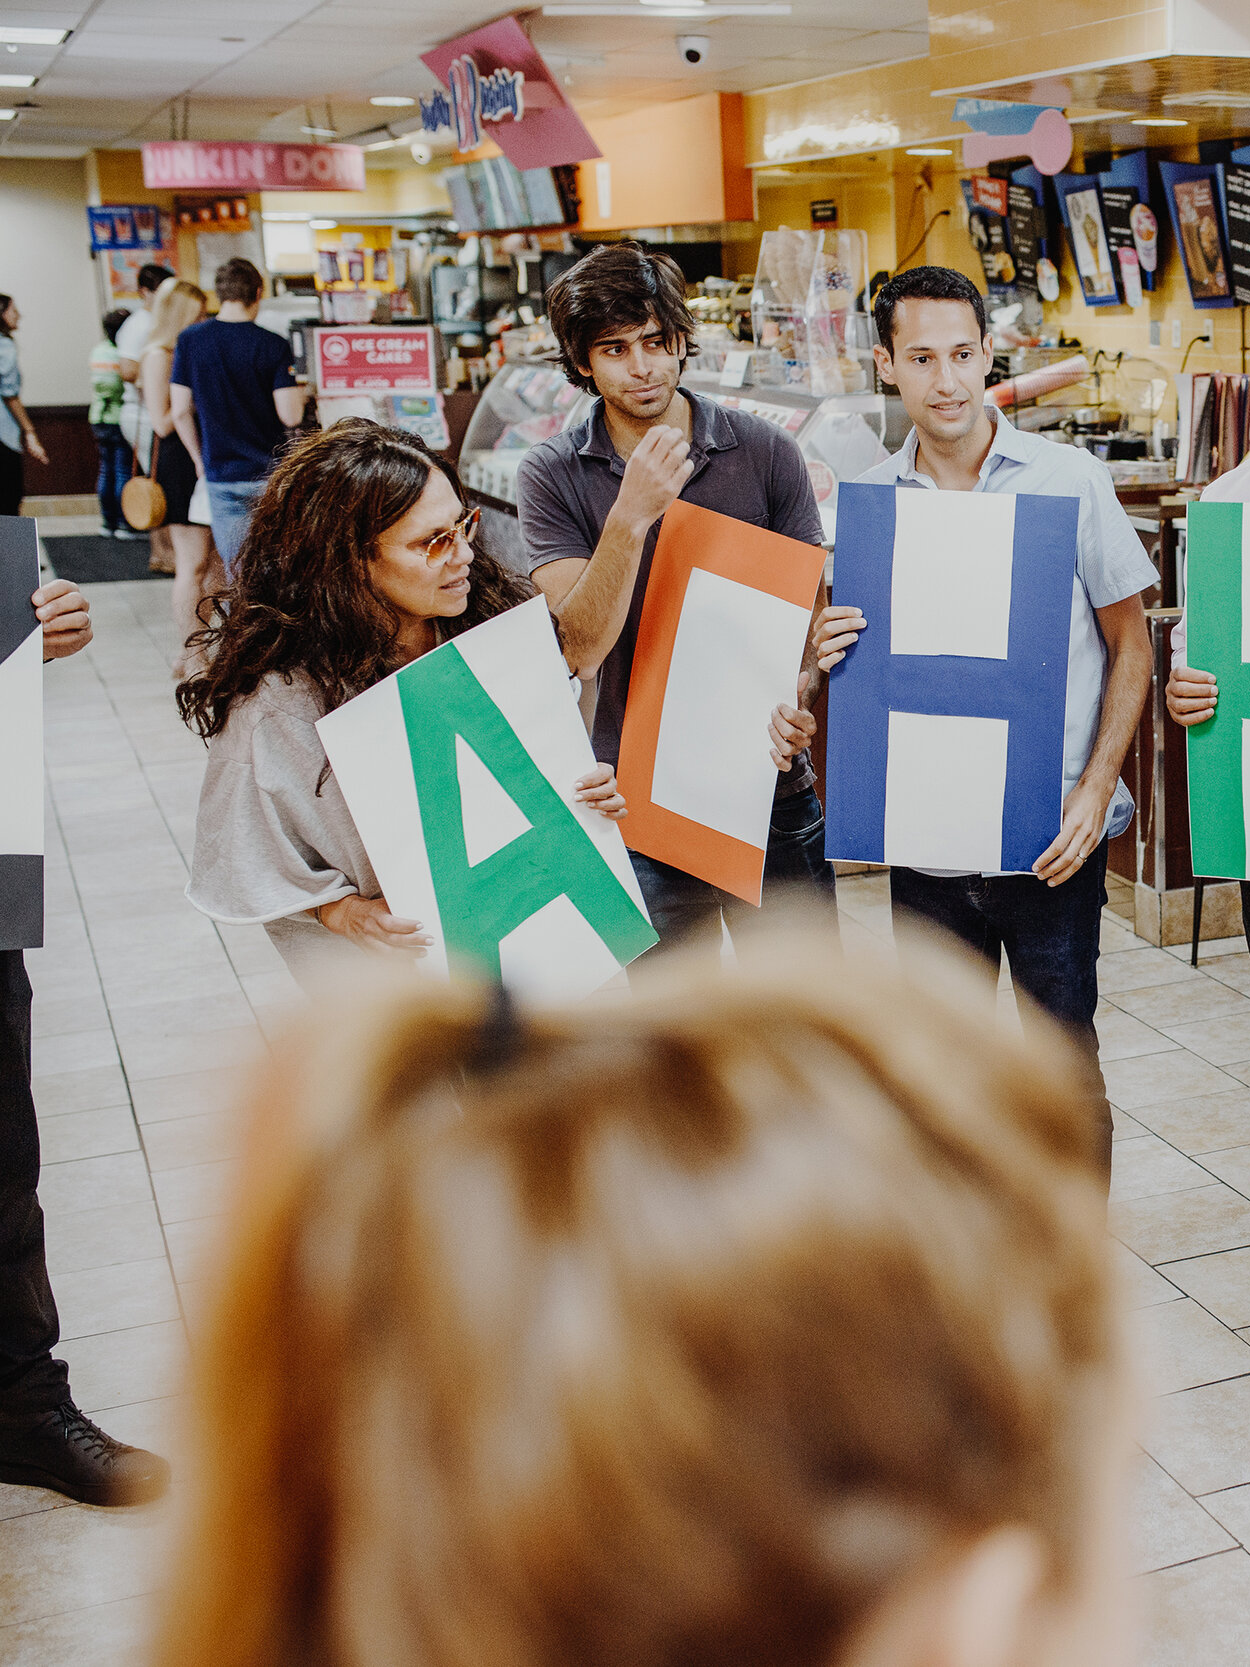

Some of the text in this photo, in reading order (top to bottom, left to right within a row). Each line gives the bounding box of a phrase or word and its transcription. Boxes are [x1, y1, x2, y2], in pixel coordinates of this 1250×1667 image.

[352, 339, 425, 352] ICE CREAM
[397, 641, 658, 1000] A
[825, 482, 1080, 875] H
